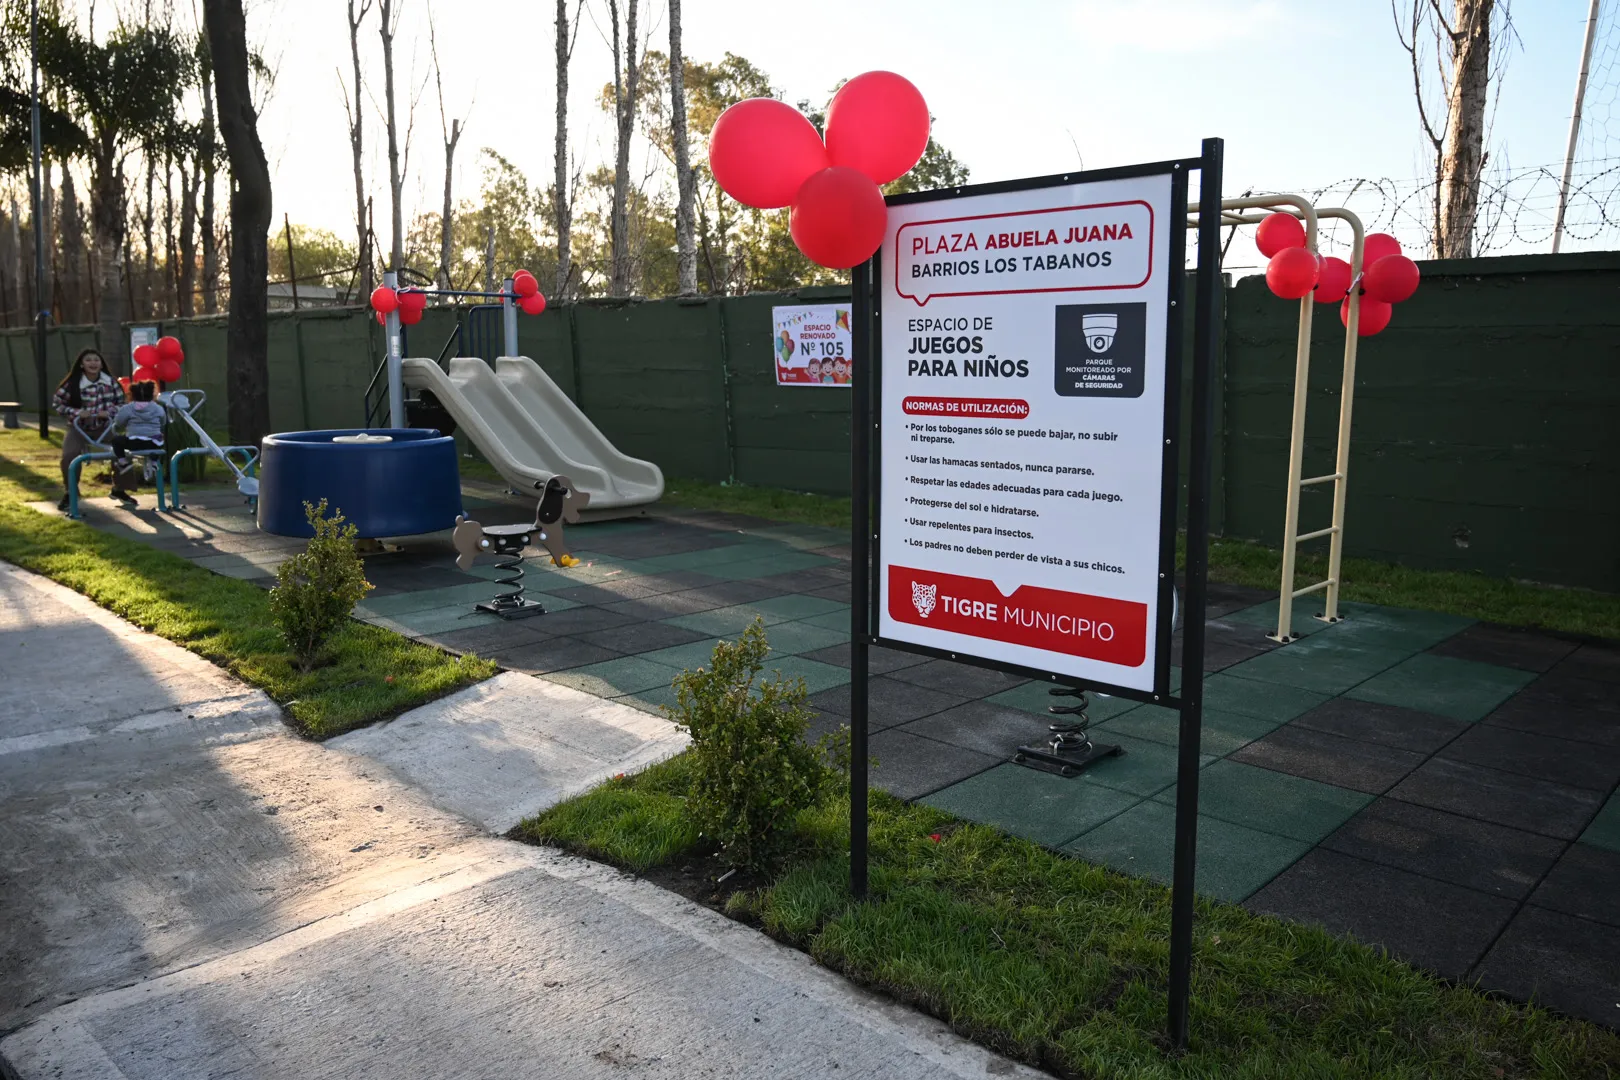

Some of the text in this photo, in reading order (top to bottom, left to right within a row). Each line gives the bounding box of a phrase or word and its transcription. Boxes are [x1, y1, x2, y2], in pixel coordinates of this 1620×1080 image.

[912, 223, 1133, 255] PLAZA ABUELA JUANA
[912, 251, 1112, 278] BARRIOS LOS TABANOS
[908, 317, 993, 331] ESPACIO DE
[820, 342, 843, 355] 105
[908, 336, 983, 354] JUEGOS
[908, 355, 1029, 378] PARA NIÑOS
[905, 401, 1028, 414] NORMAS DE UTILIZACIÓN:
[910, 423, 1118, 441] Por los toboganes sólo se puede bajar, no subir
[911, 434, 955, 445] ni treparse.
[910, 455, 1094, 476] Usar las hamacas sentados, nunca pararse.
[910, 476, 1123, 503] Respetar las edades adecuadas para cada juego.
[910, 497, 953, 509] Protegerse
[954, 501, 967, 510] del
[969, 503, 982, 511] sol
[991, 505, 1039, 517] hidratarse.
[910, 518, 1034, 539] Usar repelentes para insectos.
[910, 538, 923, 547] Los
[925, 540, 951, 551] padres
[953, 544, 964, 552] no
[966, 545, 992, 556] deben
[995, 549, 1024, 561] perder
[1027, 553, 1039, 562] de
[1041, 555, 1063, 565] vista
[1073, 560, 1089, 569] sus
[1091, 561, 1125, 574] chicos.
[941, 595, 1114, 641] TIGRE MUNICIPIO
